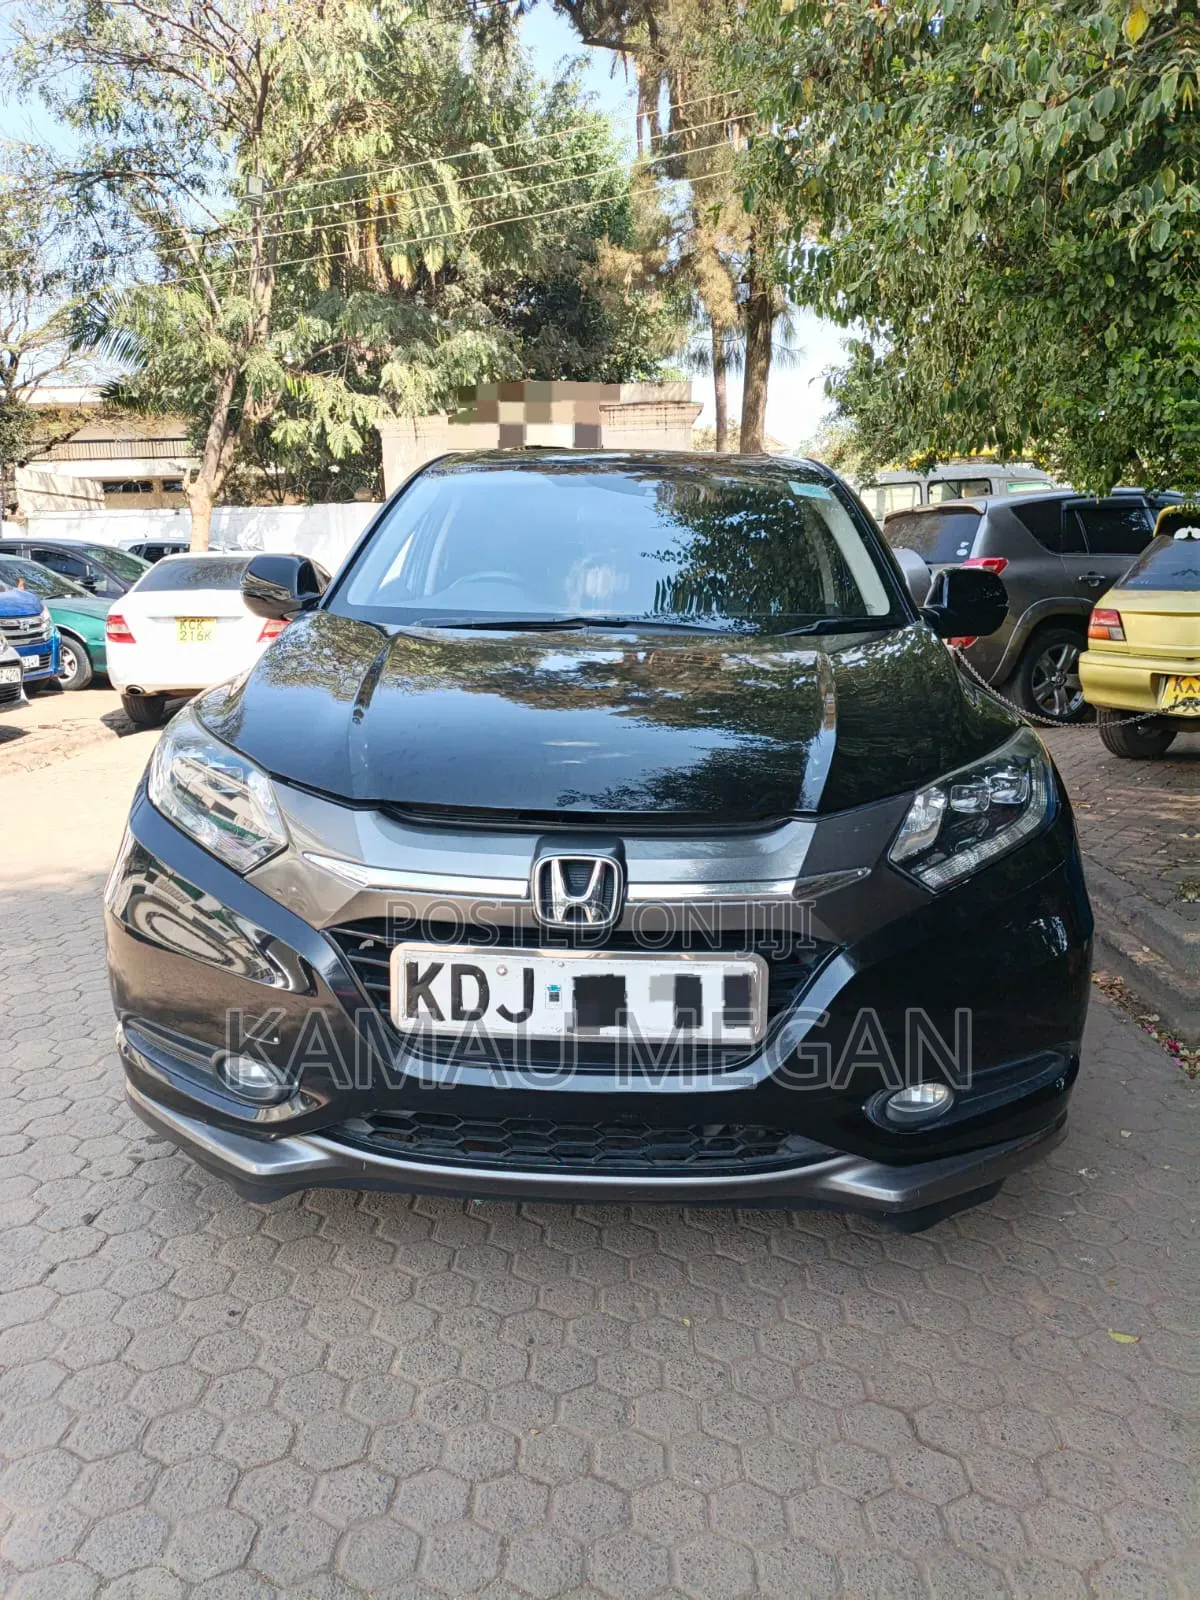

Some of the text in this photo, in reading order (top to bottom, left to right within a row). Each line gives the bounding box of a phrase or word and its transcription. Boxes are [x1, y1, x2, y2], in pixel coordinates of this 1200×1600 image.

[179, 619, 204, 630] KCK
[179, 630, 212, 641] 216K
[405, 961, 535, 1024] KDJ
